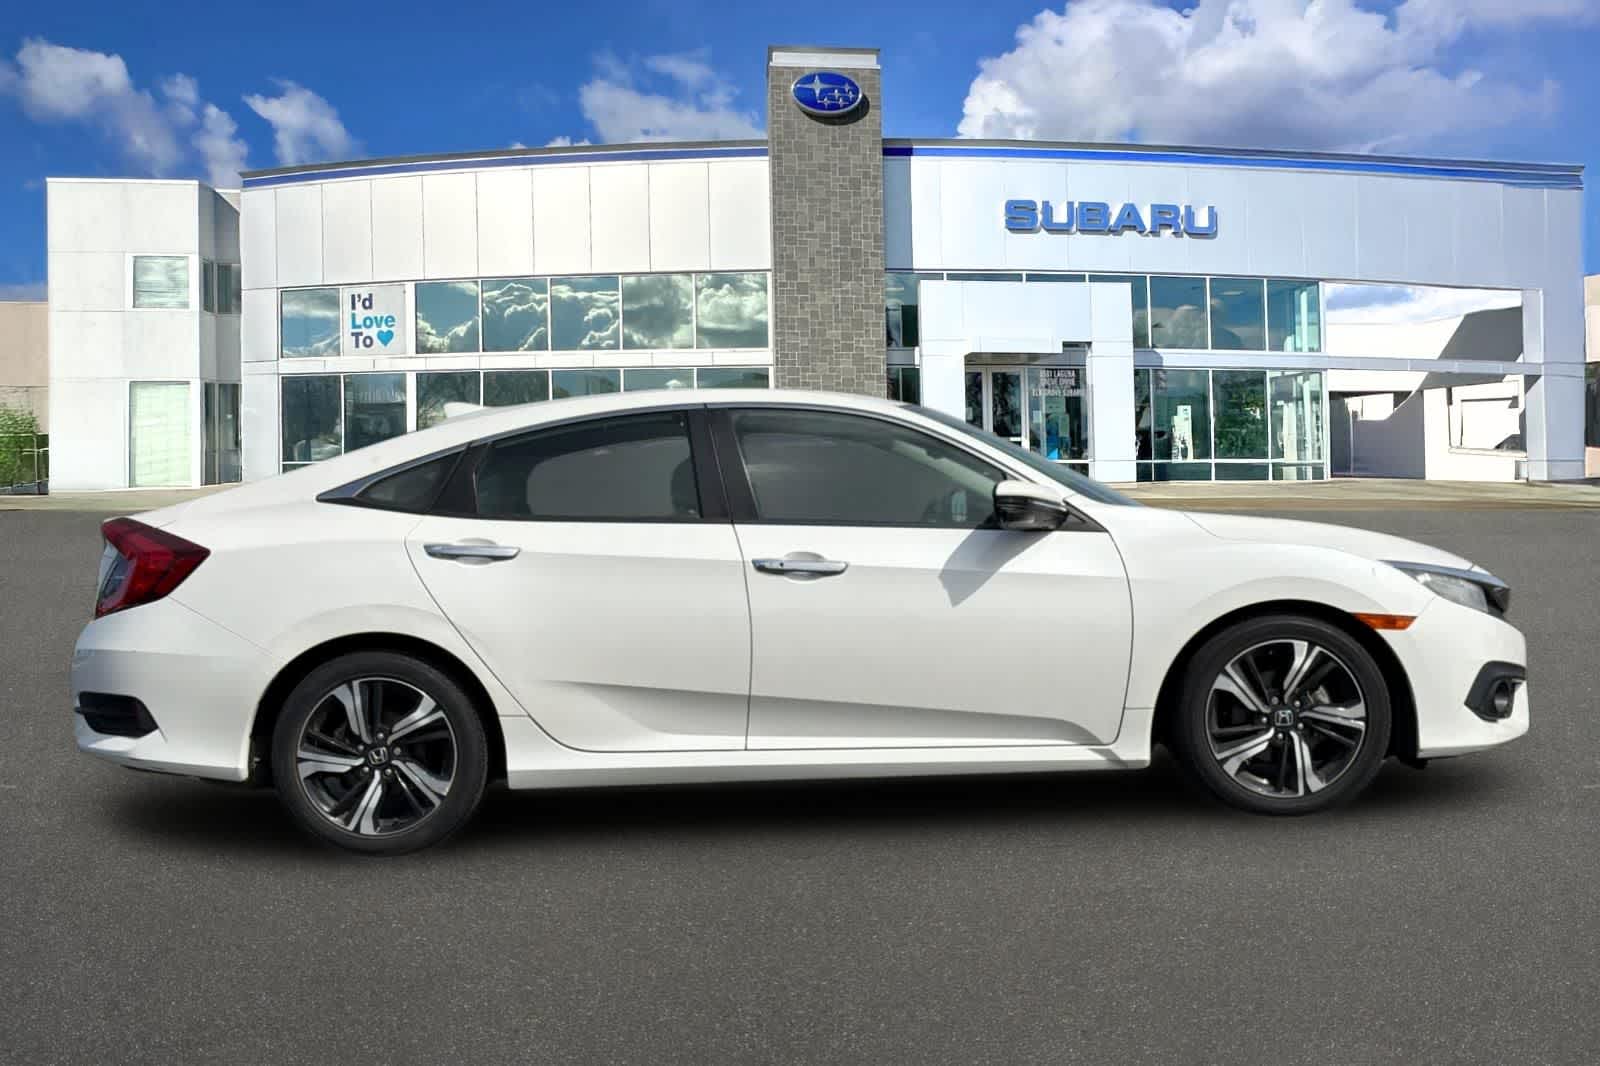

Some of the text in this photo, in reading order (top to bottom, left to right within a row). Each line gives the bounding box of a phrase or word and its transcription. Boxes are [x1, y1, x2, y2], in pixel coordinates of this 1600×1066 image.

[1005, 199, 1217, 237] SUBARU
[351, 293, 373, 310] I'd
[351, 312, 396, 329] Love
[351, 331, 374, 348] To
